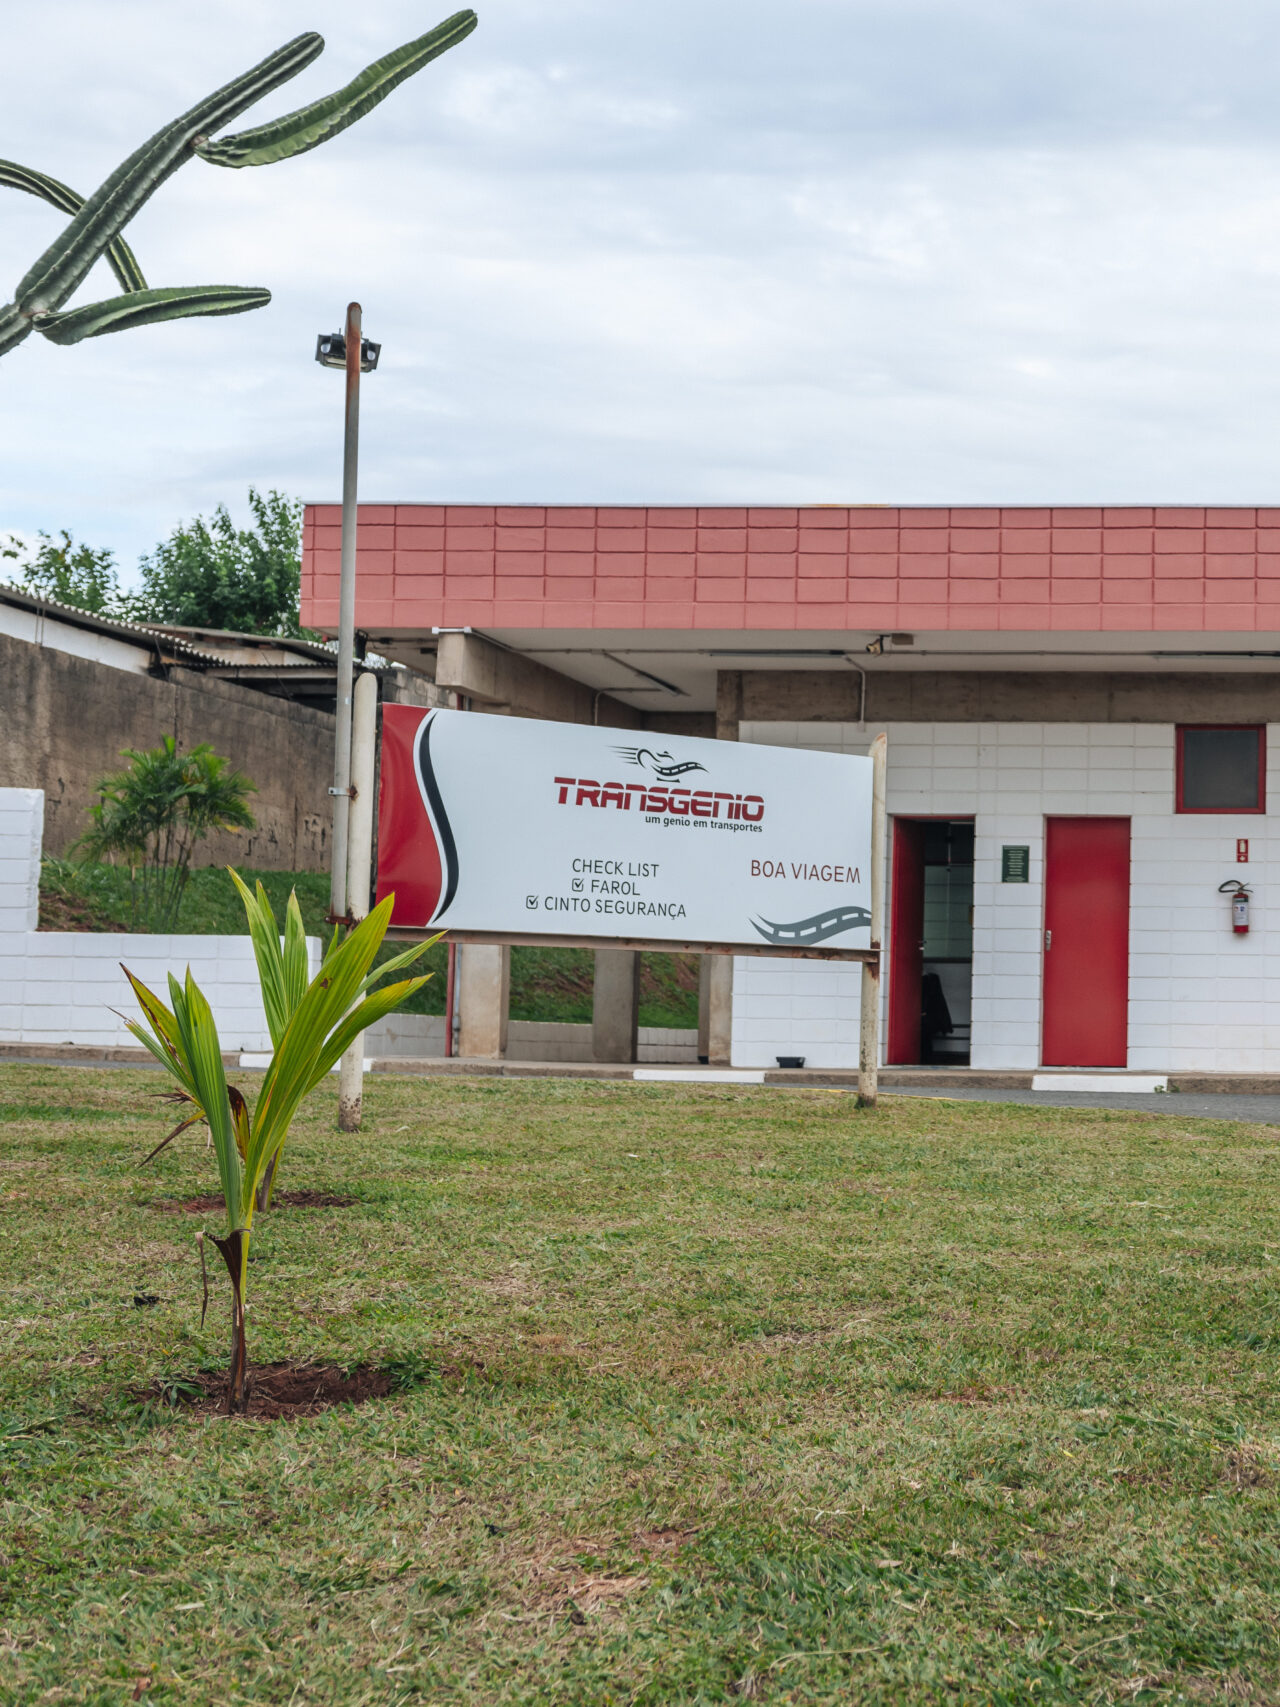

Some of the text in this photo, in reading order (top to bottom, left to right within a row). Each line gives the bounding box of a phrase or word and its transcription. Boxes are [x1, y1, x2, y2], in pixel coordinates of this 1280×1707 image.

[554, 776, 765, 822] TRANSGENIO
[645, 815, 763, 833] um genio em transportes
[572, 858, 660, 878] CHECK LIST
[750, 859, 861, 884] BOA VIAGEM
[590, 879, 641, 896] FAROL
[544, 896, 687, 920] CINTO SEGURANÇA
